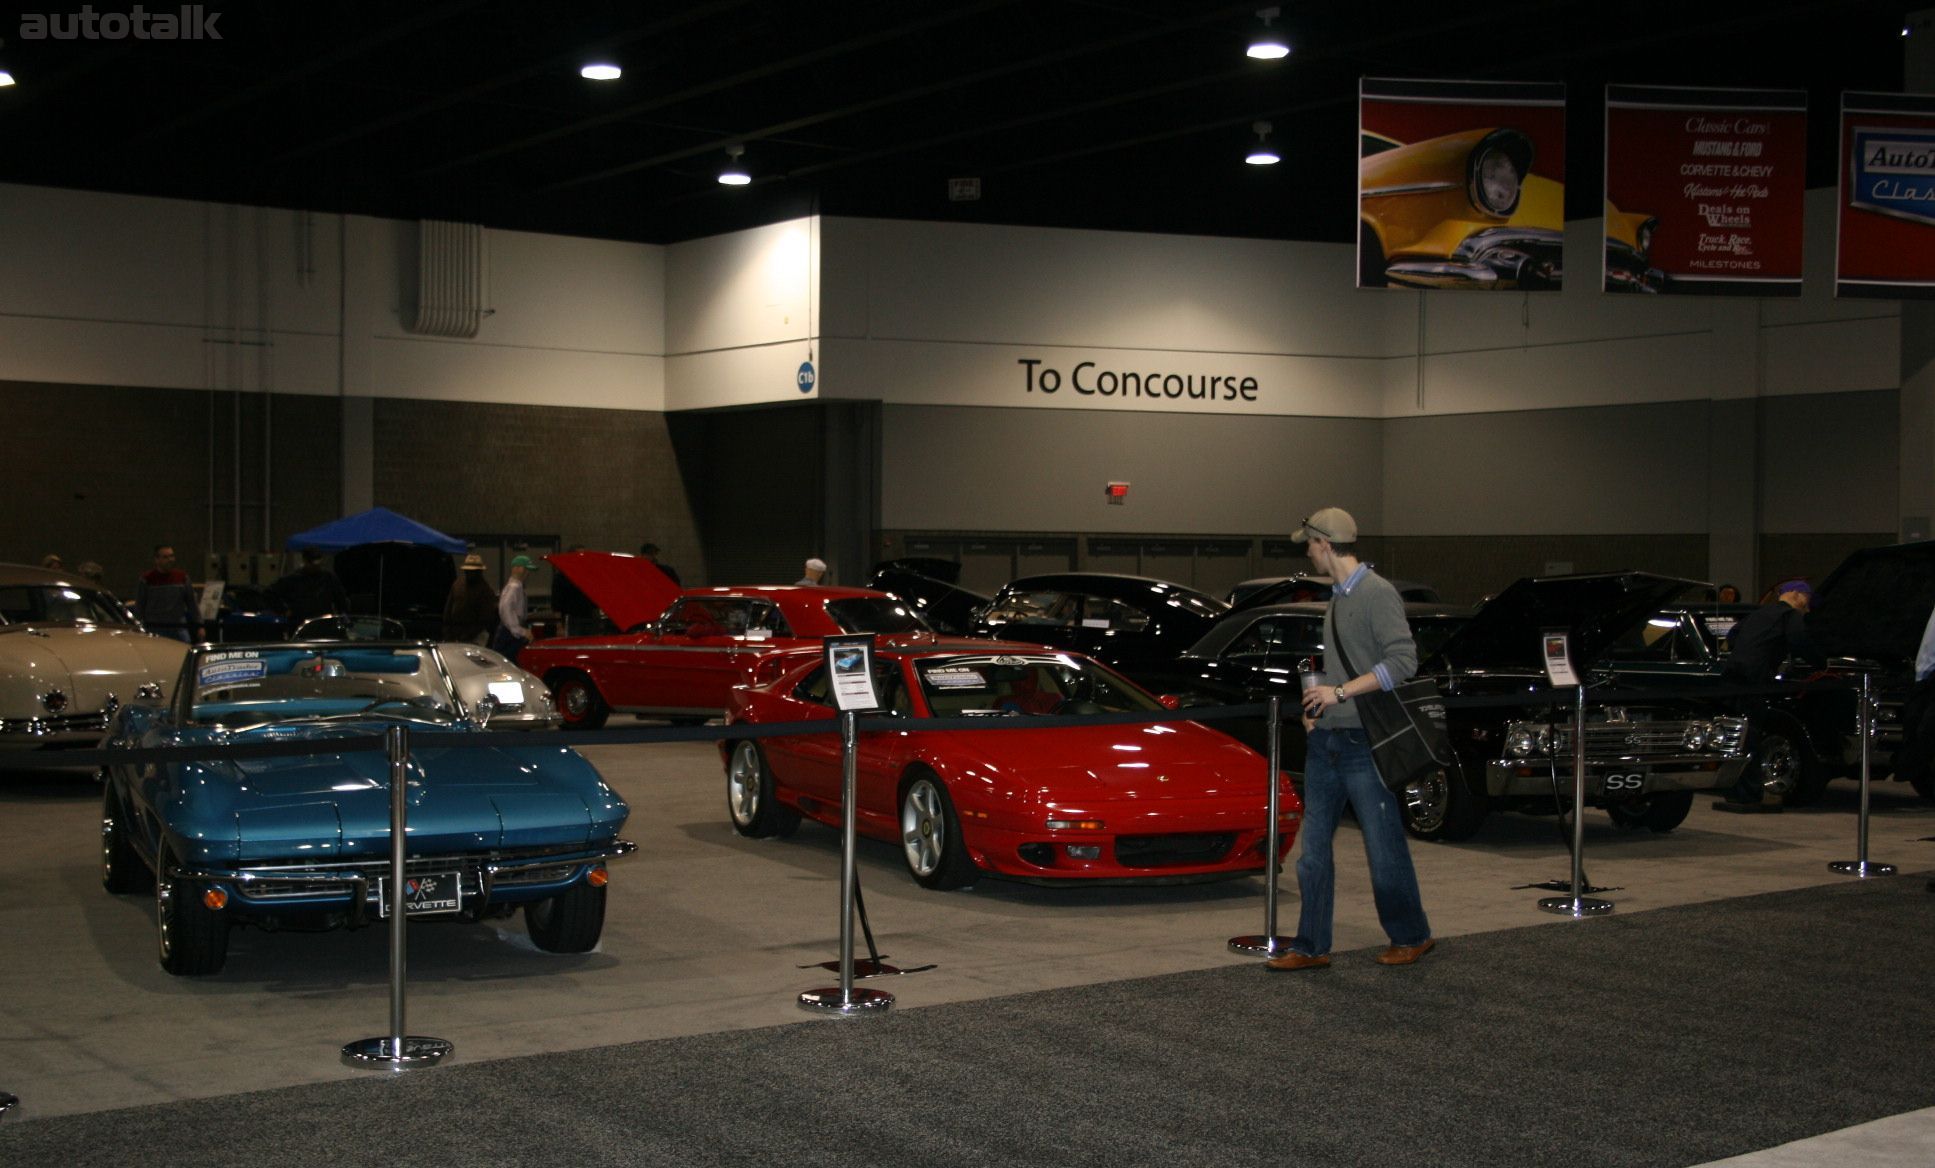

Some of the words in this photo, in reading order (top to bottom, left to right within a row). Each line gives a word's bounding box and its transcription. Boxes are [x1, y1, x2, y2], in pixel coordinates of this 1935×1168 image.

[1685, 117, 1731, 134] Classic
[1692, 141, 1732, 156] MUSTANG
[1740, 142, 1764, 157] FORD
[1680, 164, 1732, 177] CORVETTE
[1740, 165, 1774, 178] CHEVY
[1697, 203, 1732, 215] Deals
[1736, 206, 1750, 214] on
[1706, 213, 1751, 228] Wheels
[1689, 260, 1761, 270] MILESTONES
[1018, 359, 1062, 394] To
[1071, 361, 1259, 401] Concourse
[205, 652, 227, 663] FIND
[228, 651, 244, 659] ME
[1606, 773, 1643, 790] SS
[385, 900, 457, 912] CRVETTE
